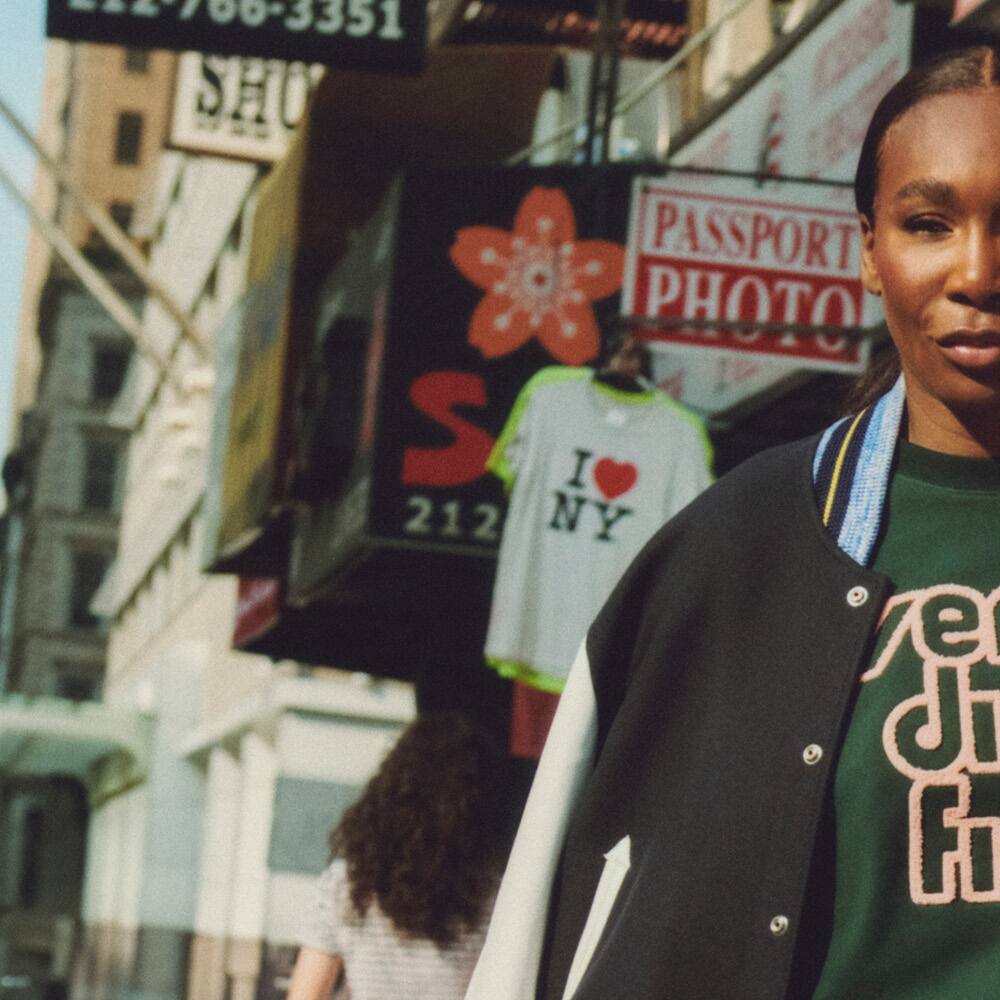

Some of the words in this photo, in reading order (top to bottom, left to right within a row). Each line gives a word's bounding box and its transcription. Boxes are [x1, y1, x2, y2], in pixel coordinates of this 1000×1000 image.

[653, 201, 858, 271] PASSPORT
[645, 264, 857, 352] PHOTO
[567, 447, 592, 488] I
[403, 495, 500, 540] 212
[549, 490, 633, 541] NY
